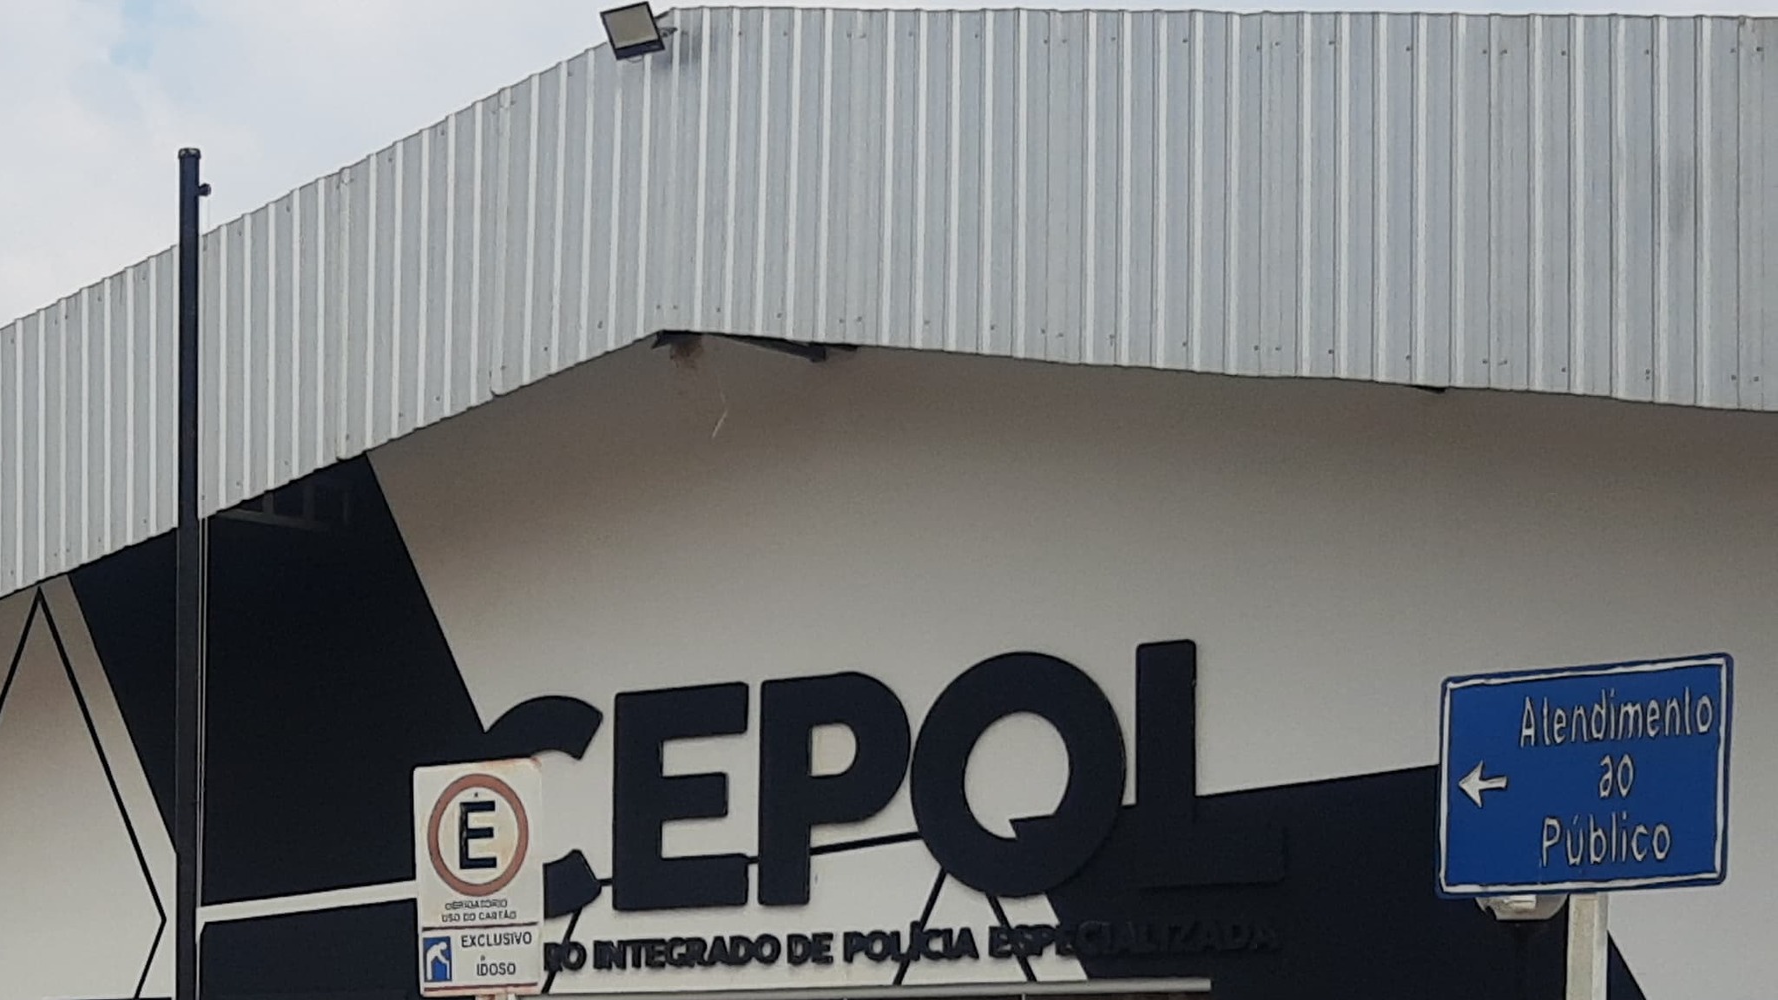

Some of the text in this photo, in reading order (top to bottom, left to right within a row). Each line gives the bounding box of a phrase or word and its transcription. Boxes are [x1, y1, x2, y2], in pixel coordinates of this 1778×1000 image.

[1599, 753, 1634, 798] ao
[459, 801, 497, 869] E
[1542, 811, 1671, 868] Público
[461, 931, 533, 949] EXCLUSIVO
[593, 934, 781, 970] INTEGRADO
[787, 934, 834, 966] DE
[843, 921, 979, 963] POLÍCIA
[476, 962, 517, 977] IDOSO
